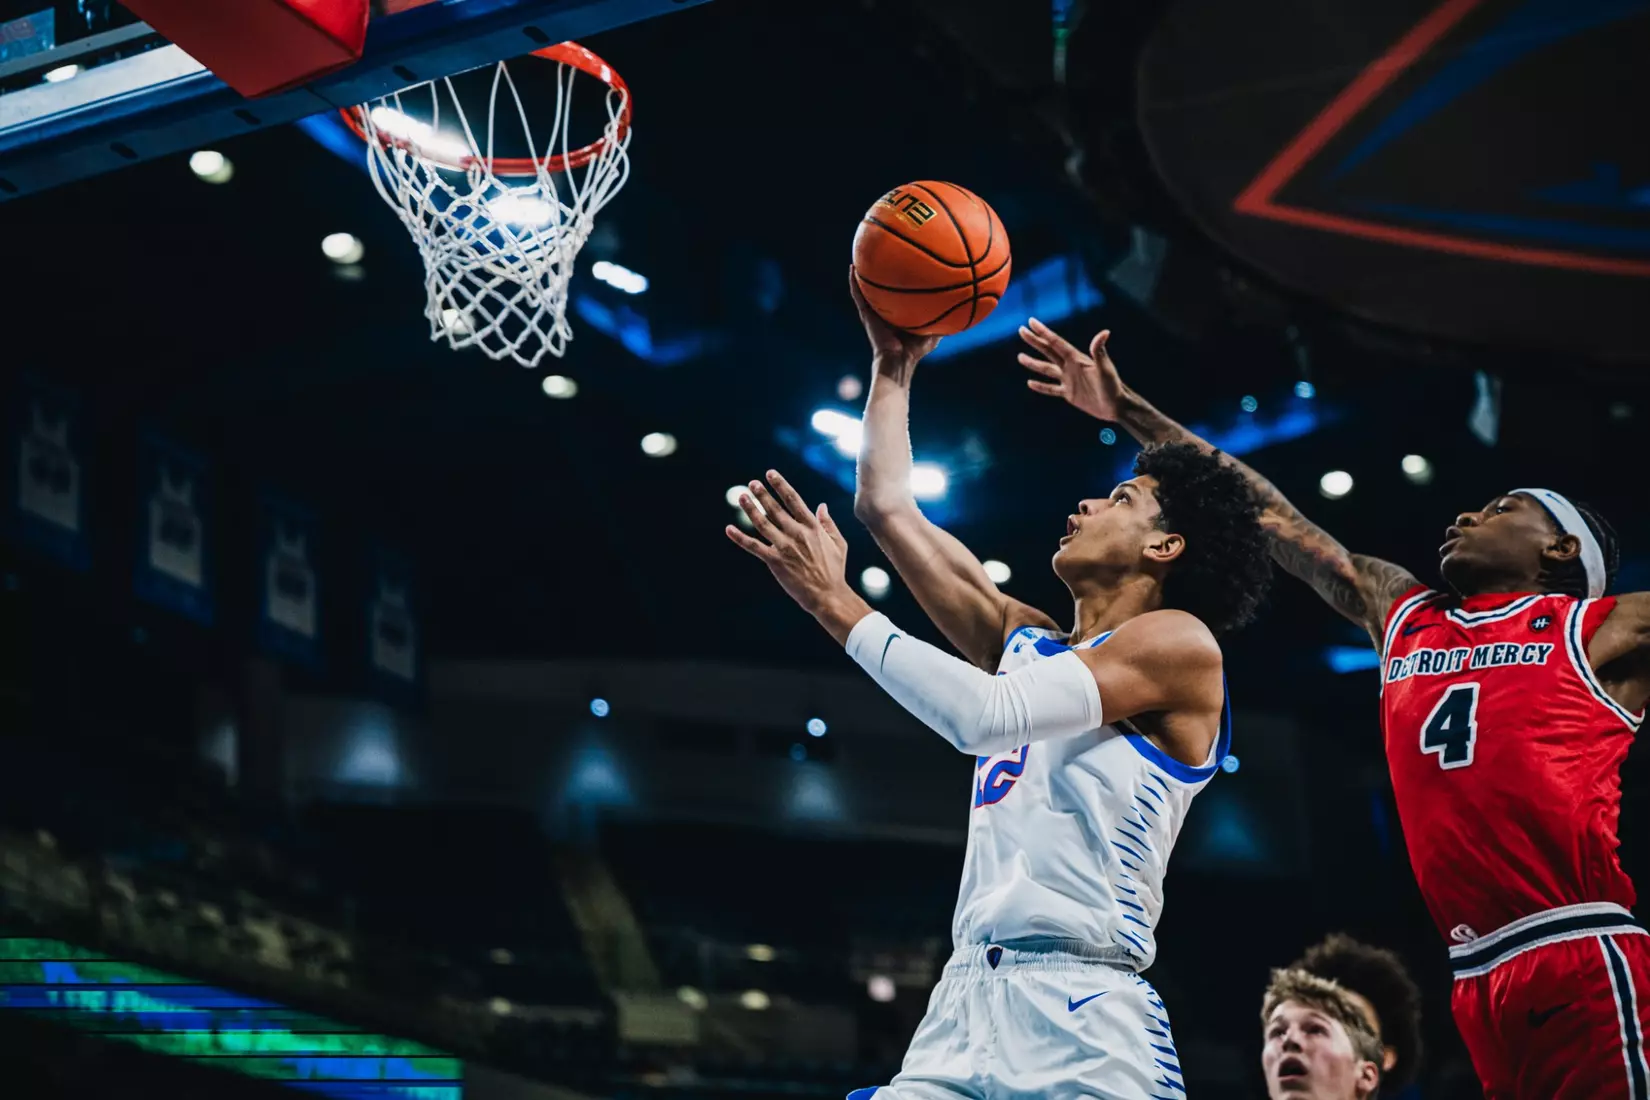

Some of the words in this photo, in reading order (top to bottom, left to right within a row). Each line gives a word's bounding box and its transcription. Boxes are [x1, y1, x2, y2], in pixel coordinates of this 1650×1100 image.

[1386, 649, 1471, 684] DETROIT
[1469, 642, 1554, 670] MERCY
[1420, 682, 1480, 770] 4
